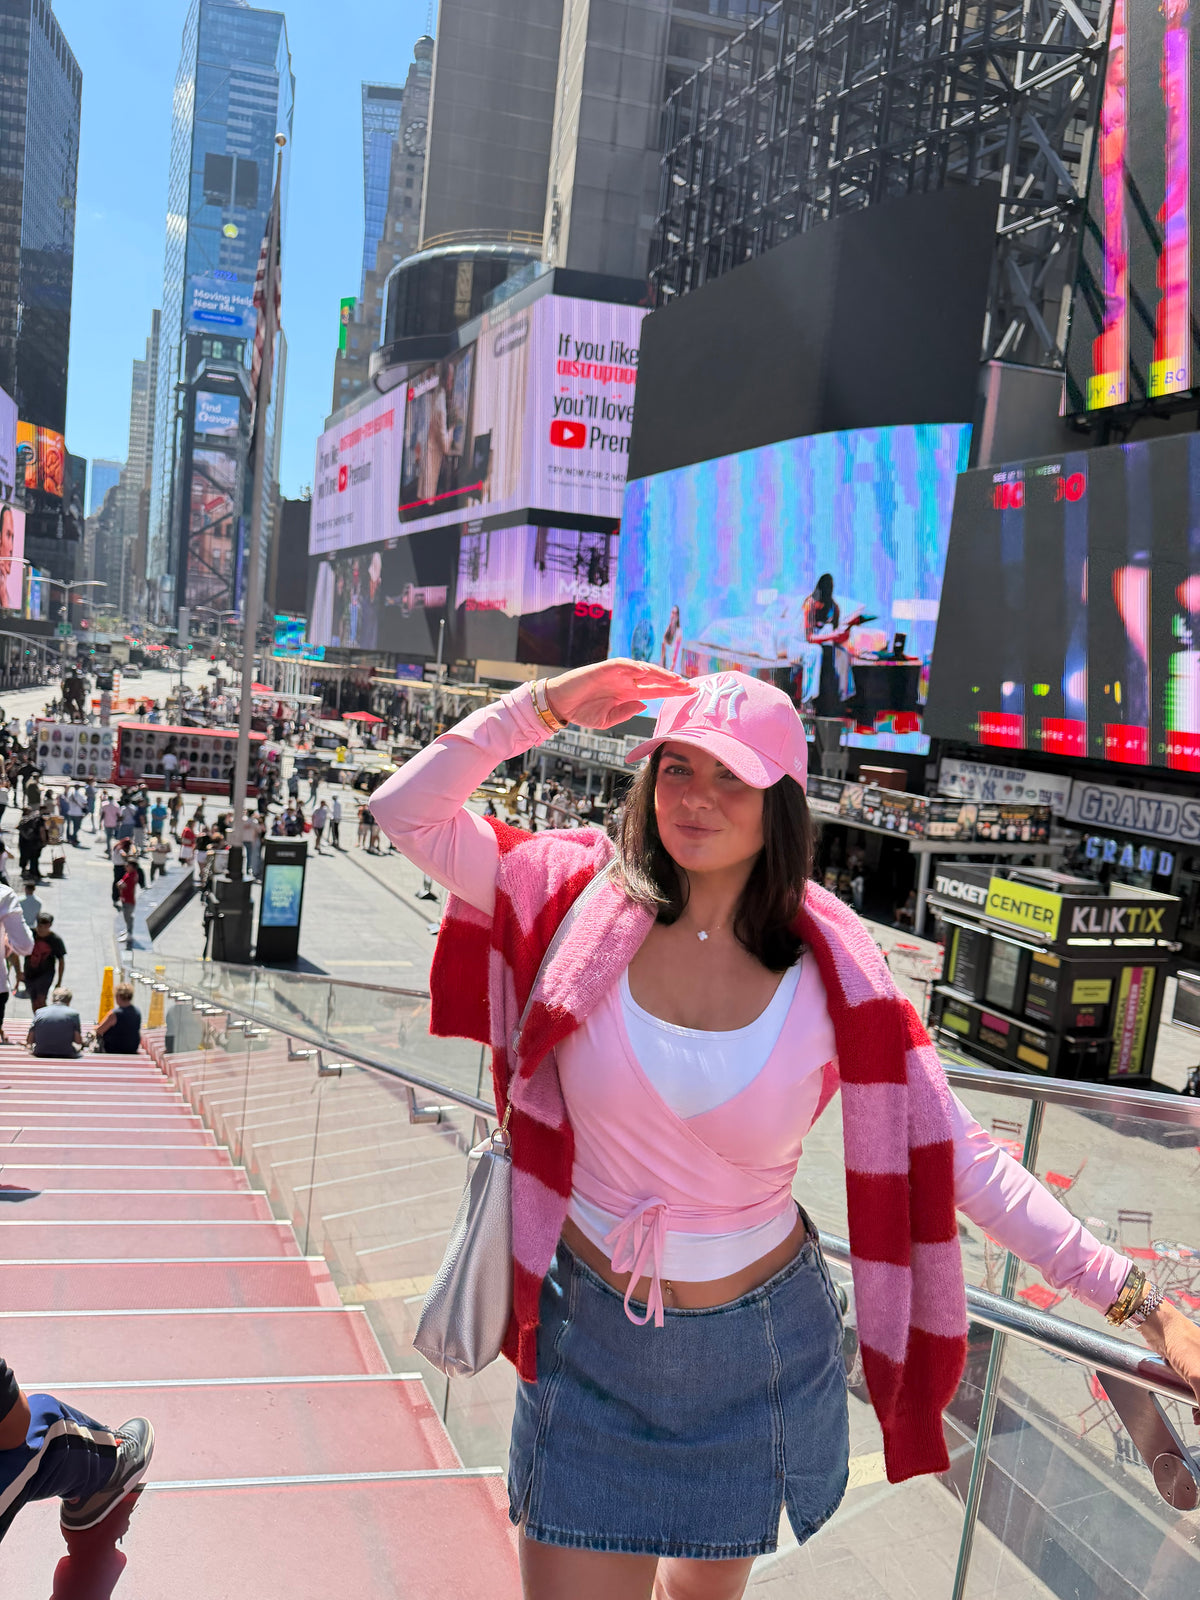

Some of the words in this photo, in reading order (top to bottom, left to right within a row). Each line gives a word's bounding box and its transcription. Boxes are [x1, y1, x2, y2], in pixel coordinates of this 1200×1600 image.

[193, 299, 218, 310] Near
[219, 303, 235, 312] Me
[194, 289, 230, 304] Moving
[558, 333, 571, 356] If
[575, 340, 605, 362] you
[610, 340, 638, 365] like
[553, 394, 598, 418] you'll
[602, 397, 634, 423] love
[559, 579, 611, 599] Most
[574, 602, 605, 619] SG
[1085, 836, 1174, 876] GRAND
[936, 876, 988, 905] TICKET
[990, 893, 1054, 923] CENTER
[1071, 906, 1166, 934] KLIKTIX
